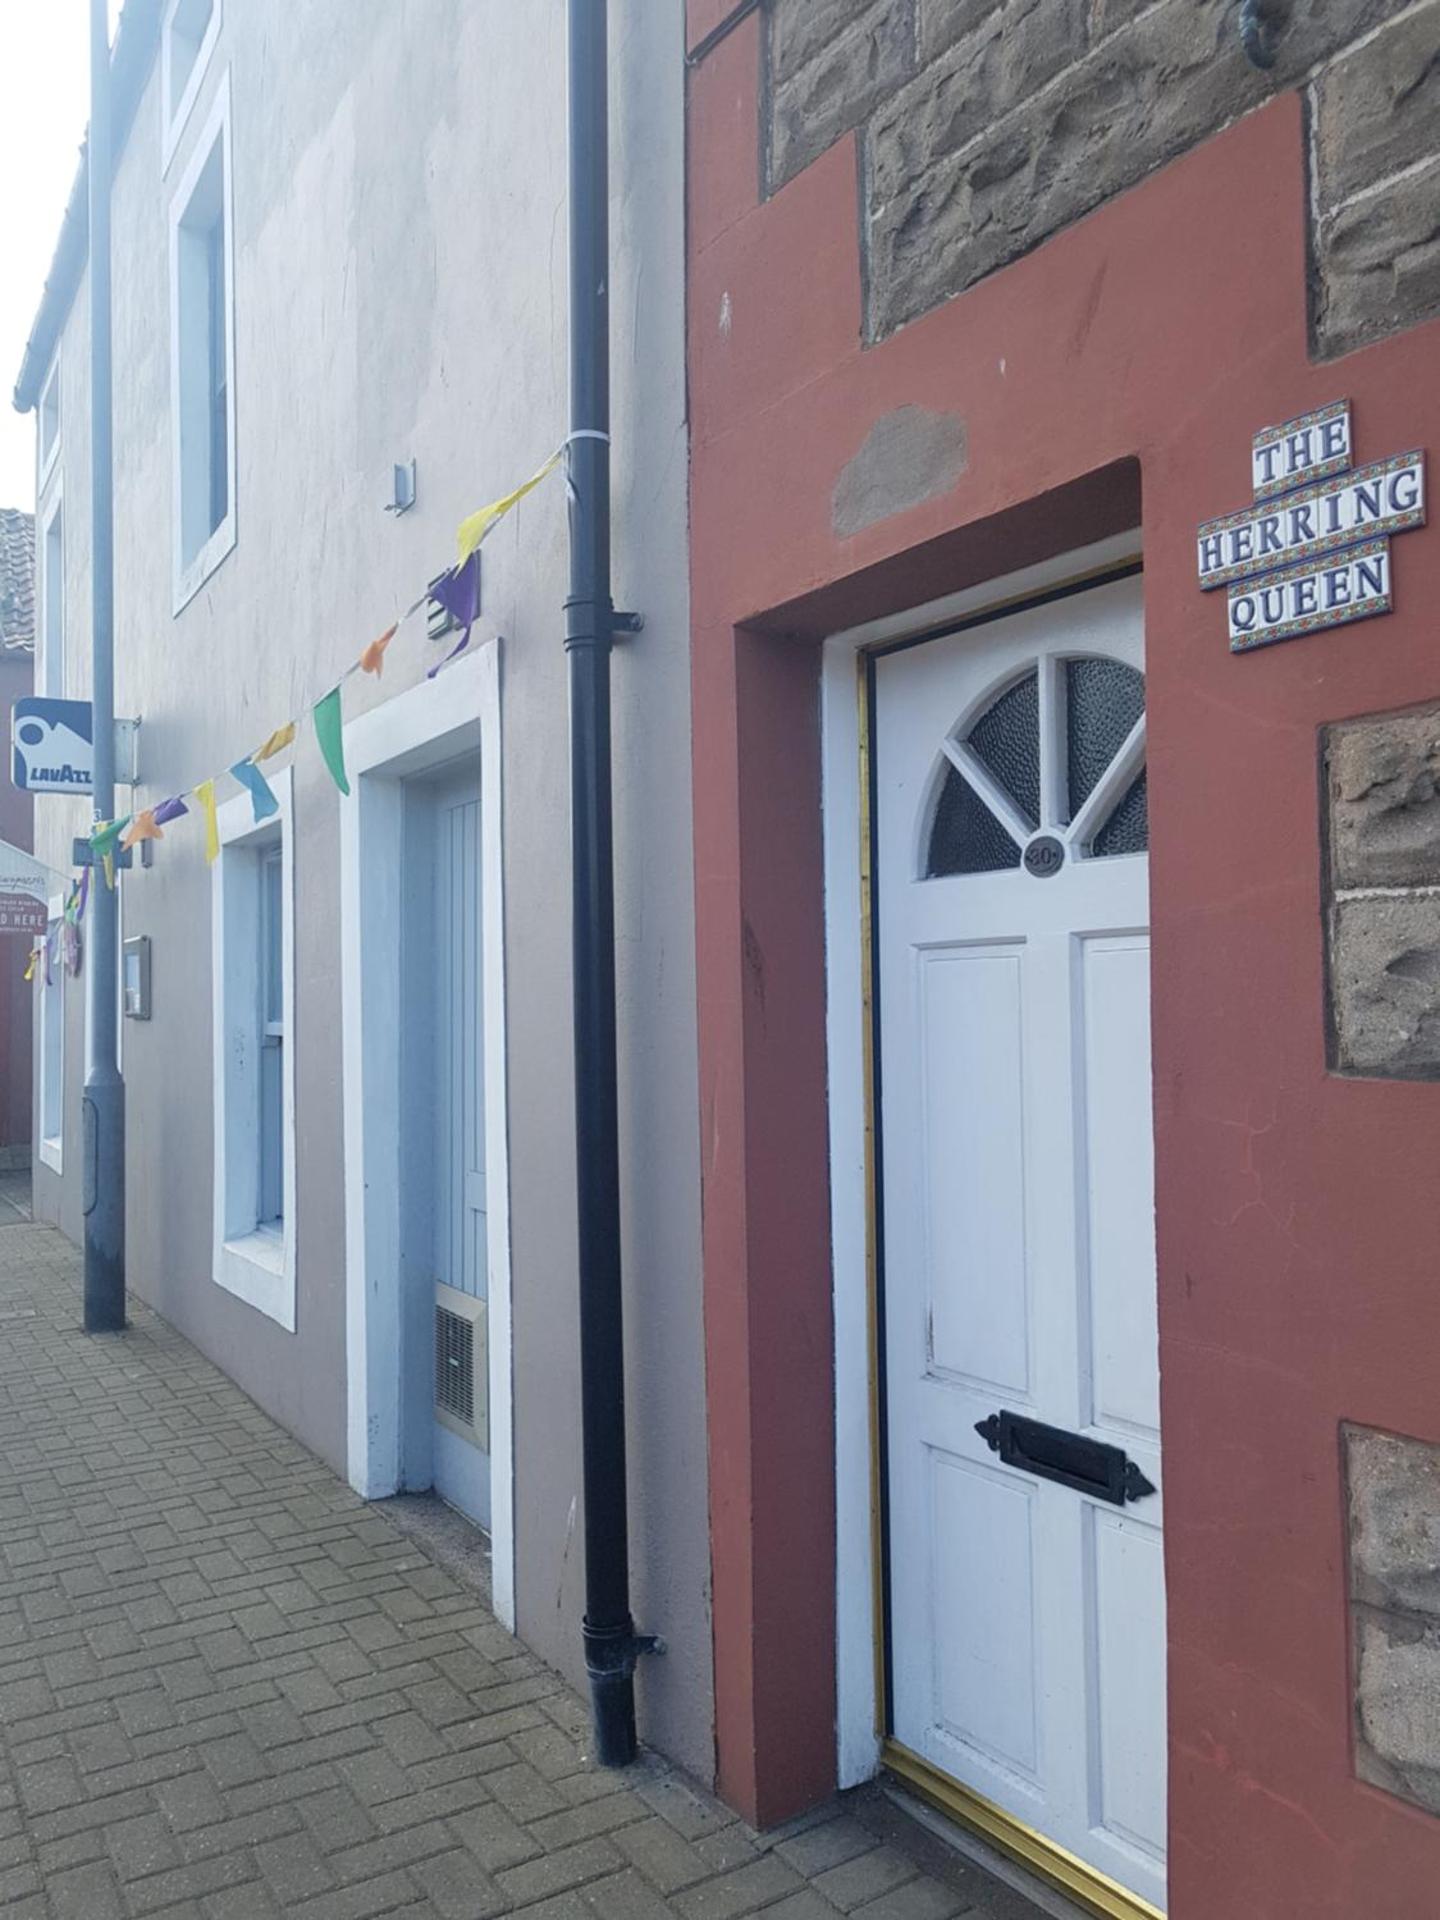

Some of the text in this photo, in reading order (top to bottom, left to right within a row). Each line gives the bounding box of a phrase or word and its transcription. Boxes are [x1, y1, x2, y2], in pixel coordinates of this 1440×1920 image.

[1255, 416, 1347, 483] THE
[1199, 469, 1418, 573] HERRING
[1230, 555, 1384, 633] QUEEN
[30, 764, 92, 784] LAVAZZ
[14, 914, 43, 927] HERE
